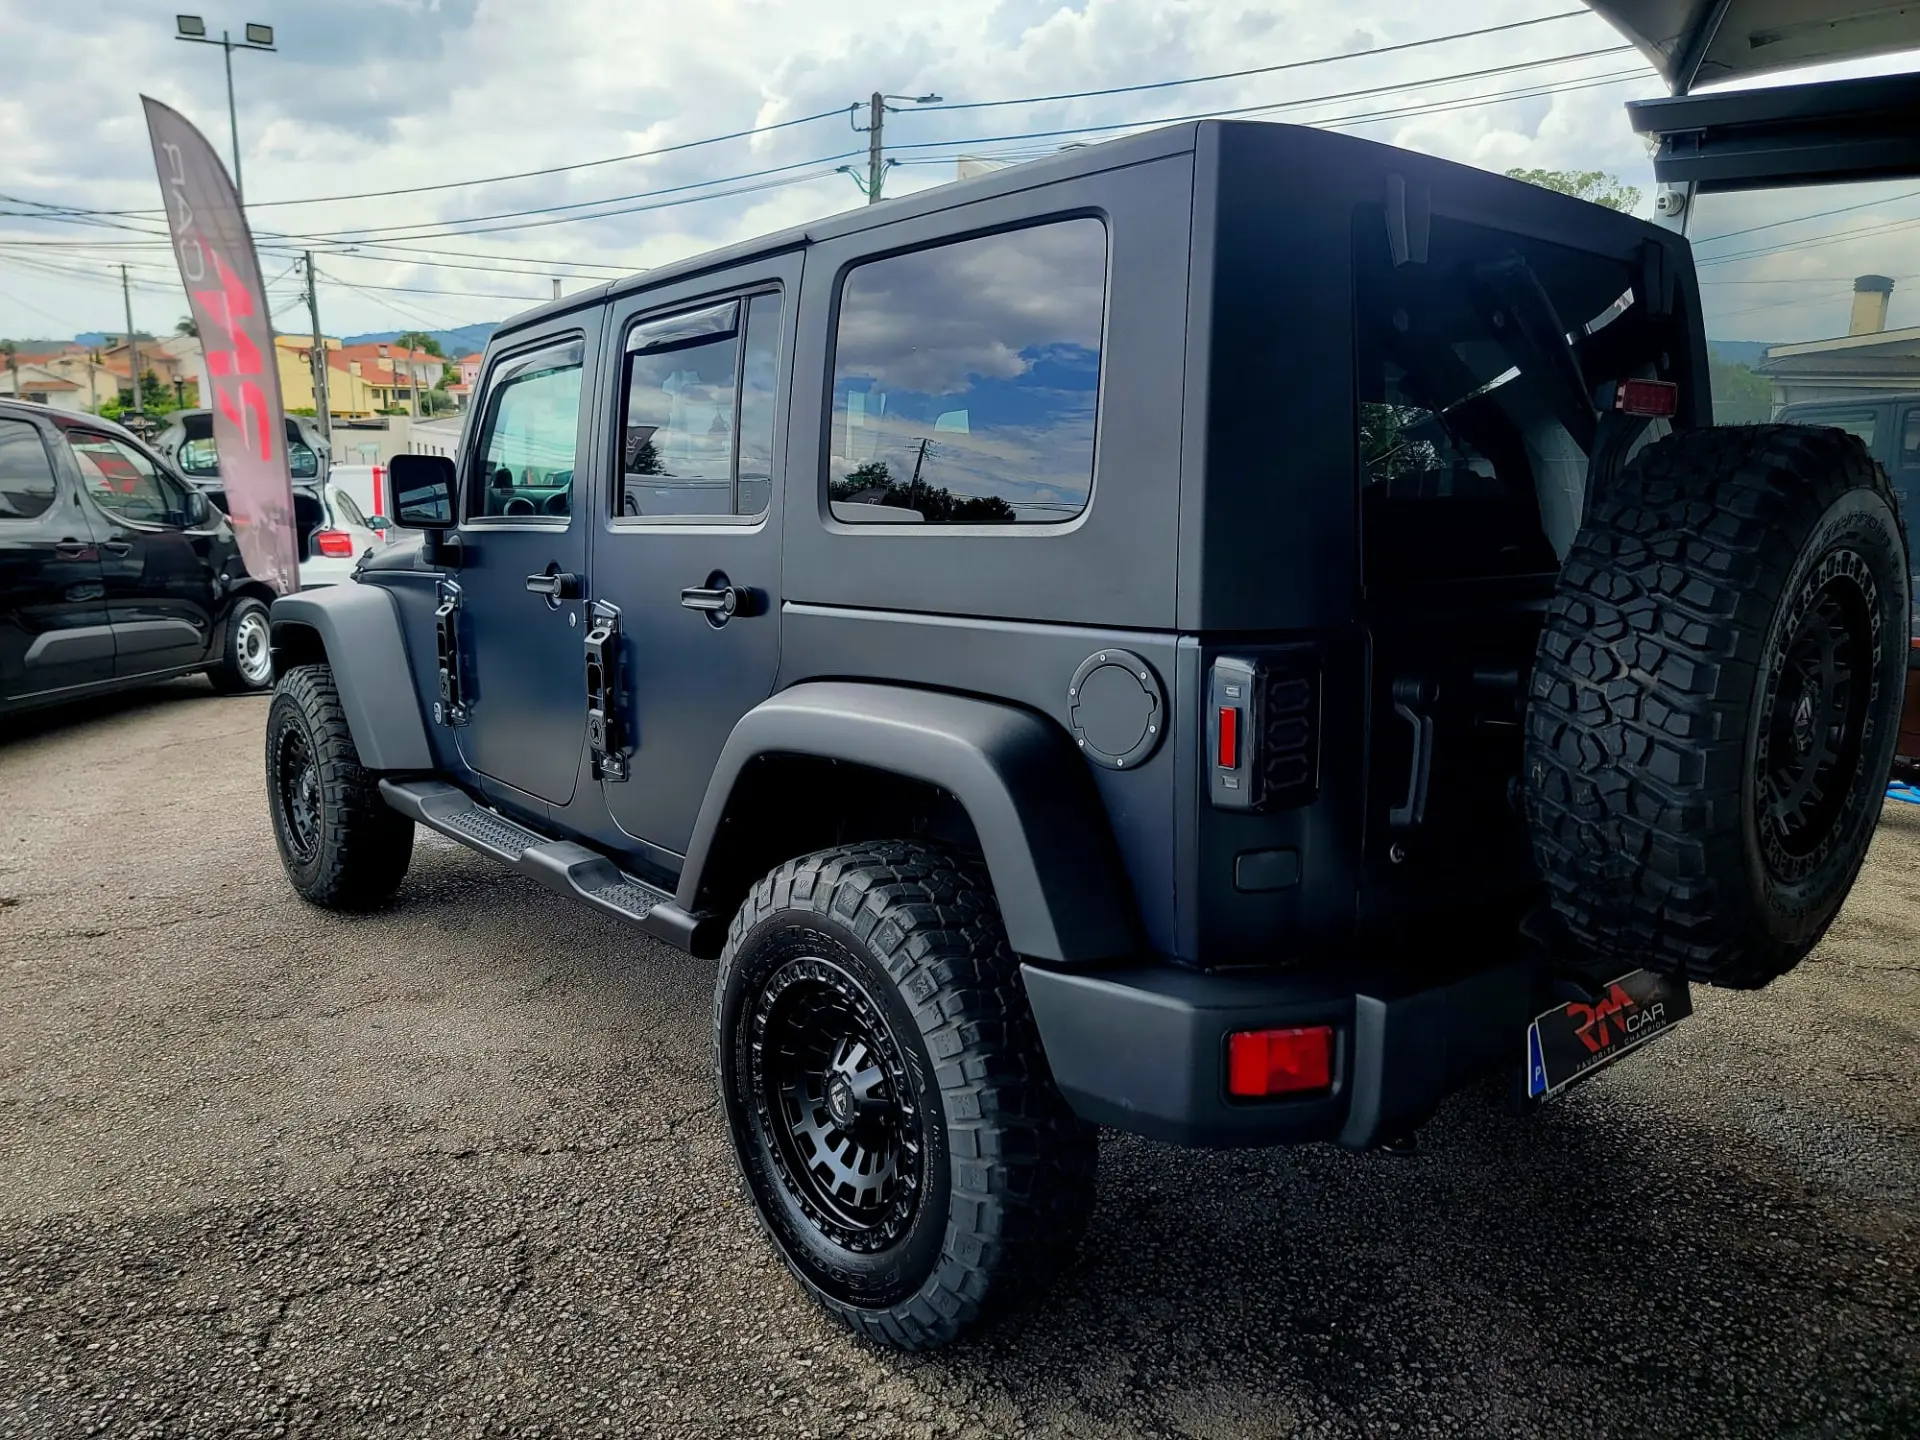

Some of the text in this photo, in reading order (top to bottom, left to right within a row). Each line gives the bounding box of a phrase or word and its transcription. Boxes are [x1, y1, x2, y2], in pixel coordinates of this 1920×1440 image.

[1626, 1002, 1665, 1033] CAR
[1624, 1020, 1667, 1045] CHAMPION
[1535, 1066, 1542, 1082] P
